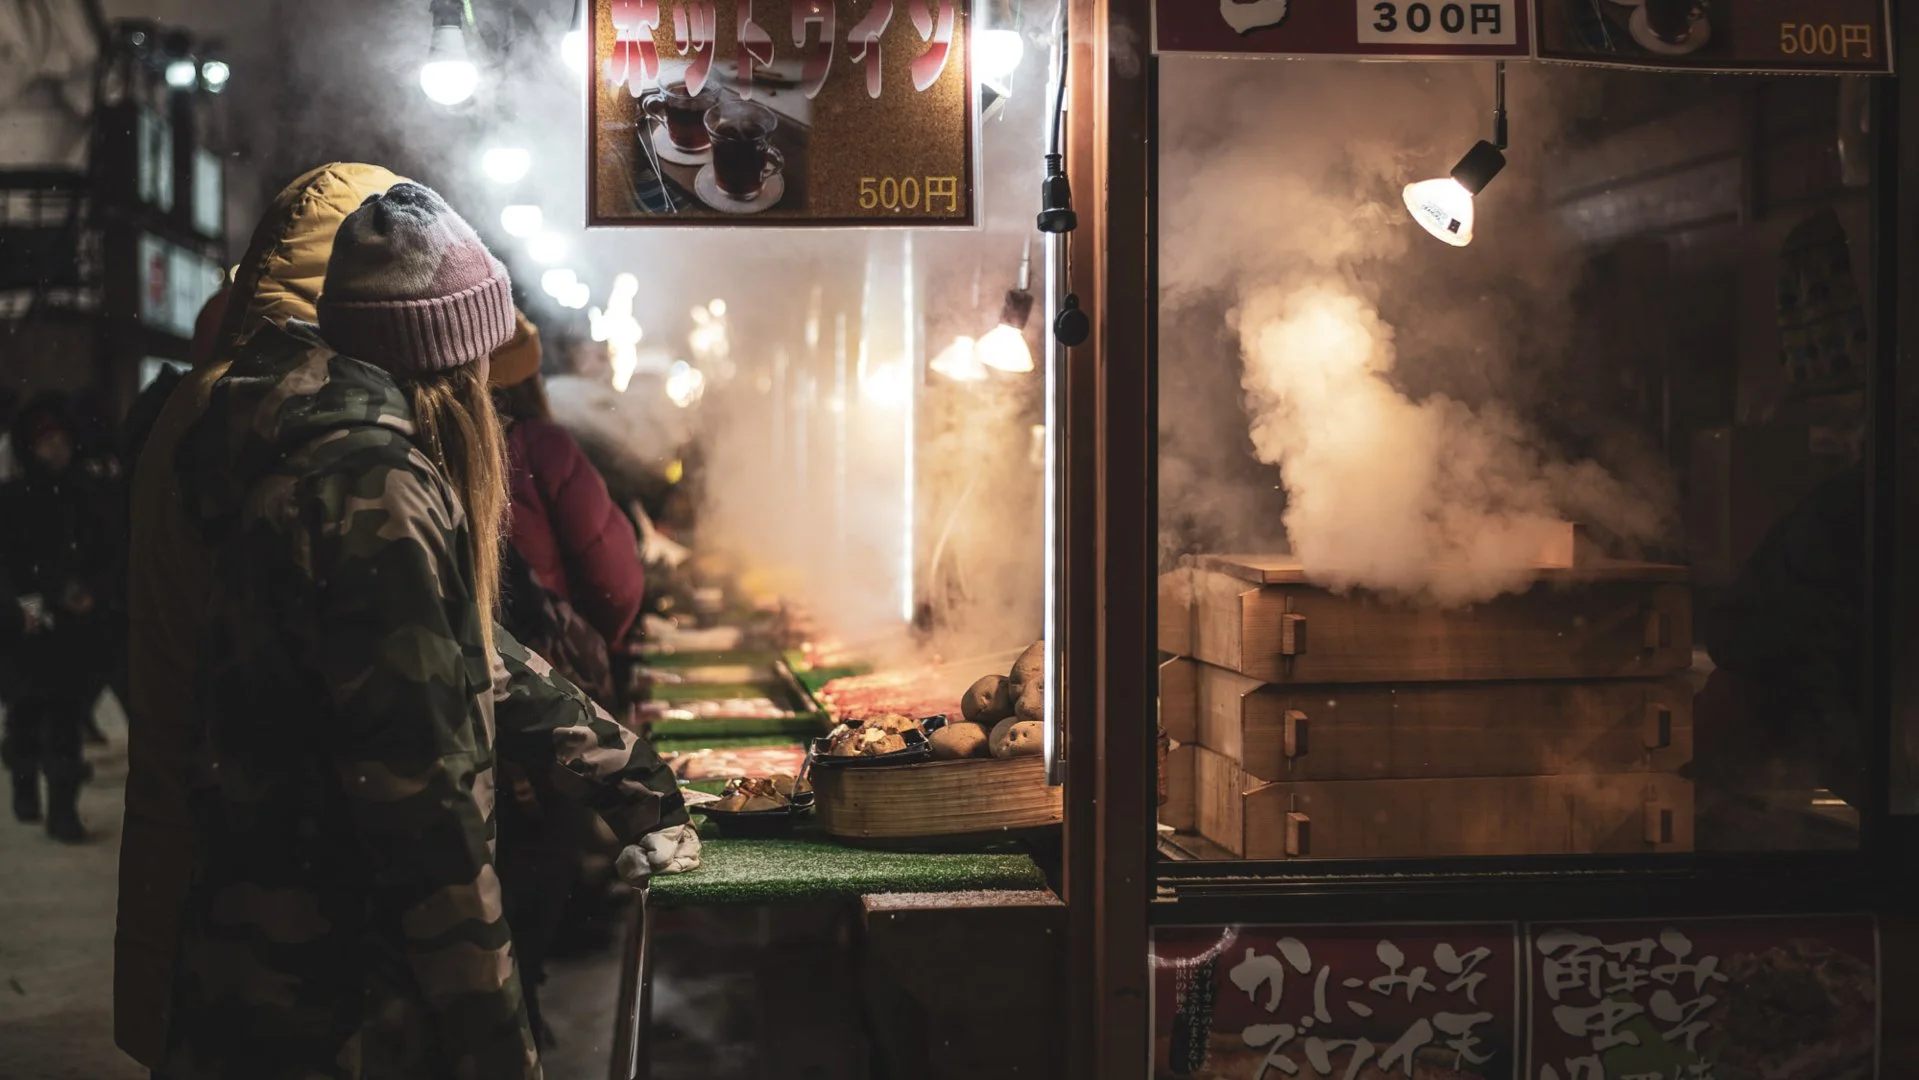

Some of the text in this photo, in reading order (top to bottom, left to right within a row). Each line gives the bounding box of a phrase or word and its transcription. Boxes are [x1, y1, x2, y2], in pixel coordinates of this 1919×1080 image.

[1372, 2, 1502, 34] 300円
[1780, 23, 1873, 59] 500円
[859, 176, 958, 213] 500円
[1229, 936, 1493, 1024] かにみそ
